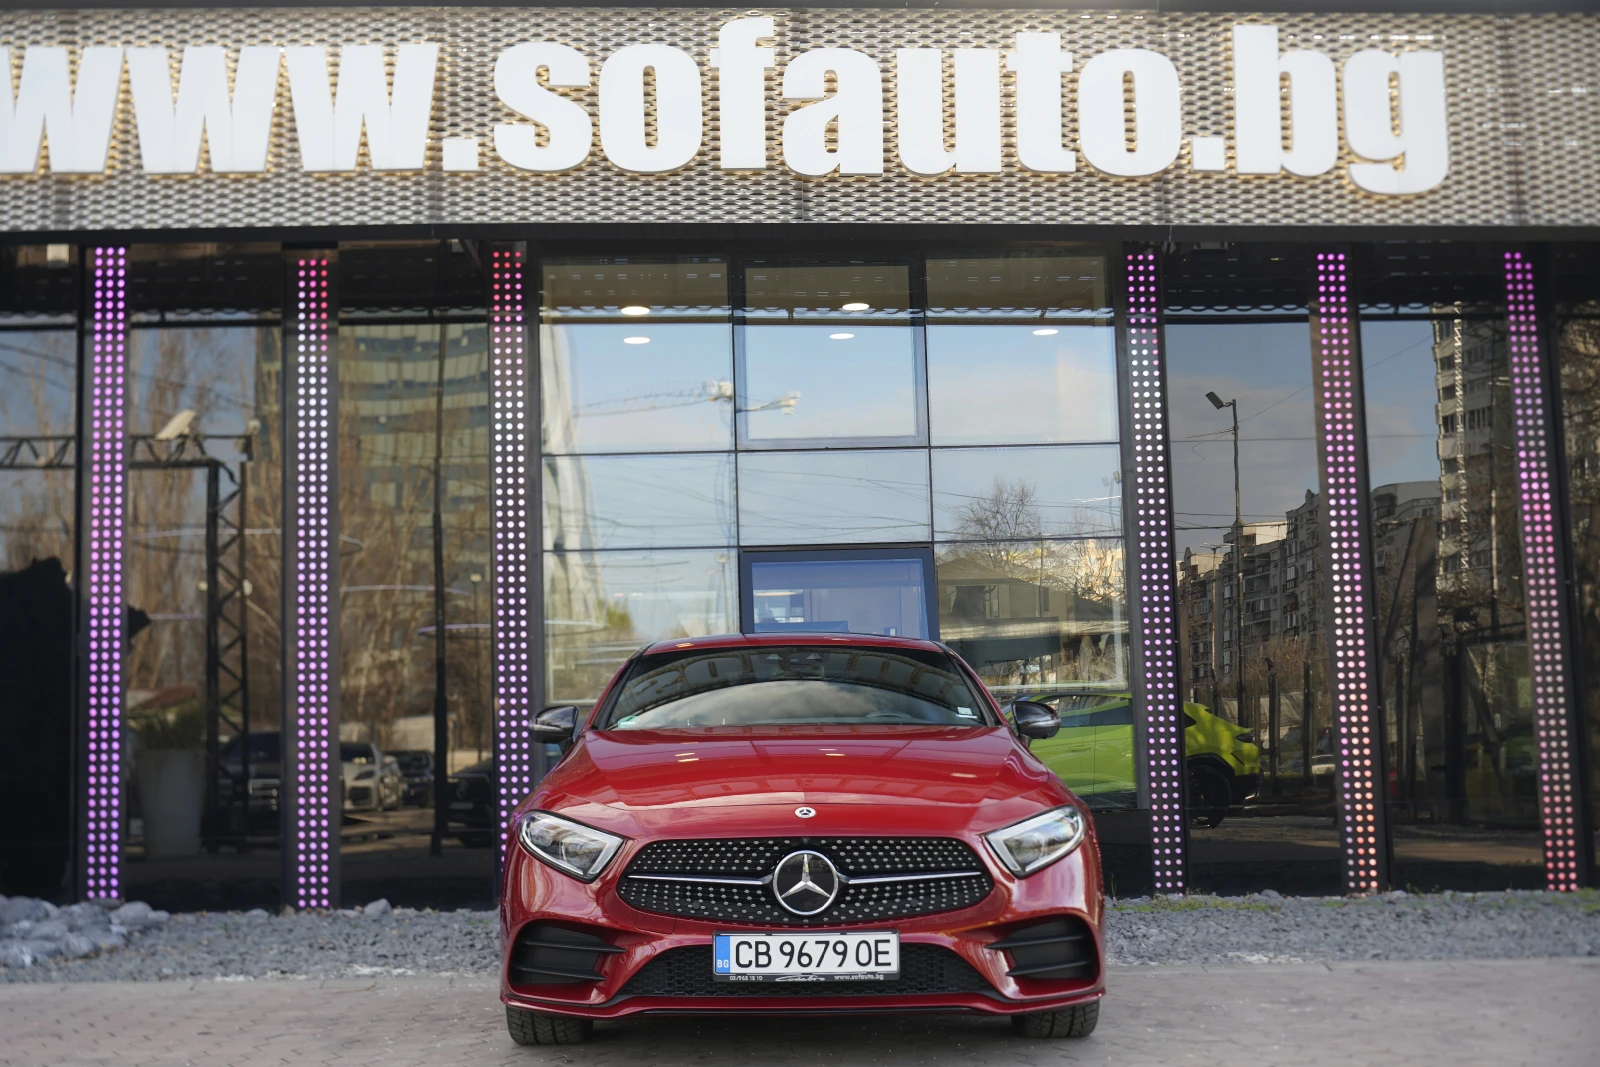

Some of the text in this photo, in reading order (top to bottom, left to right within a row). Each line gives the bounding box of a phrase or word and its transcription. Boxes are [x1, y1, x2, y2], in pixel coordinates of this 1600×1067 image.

[0, 17, 1449, 197] www.sofauto.bg
[717, 959, 729, 968] BG
[735, 940, 772, 968] CB
[779, 940, 848, 968] 9679
